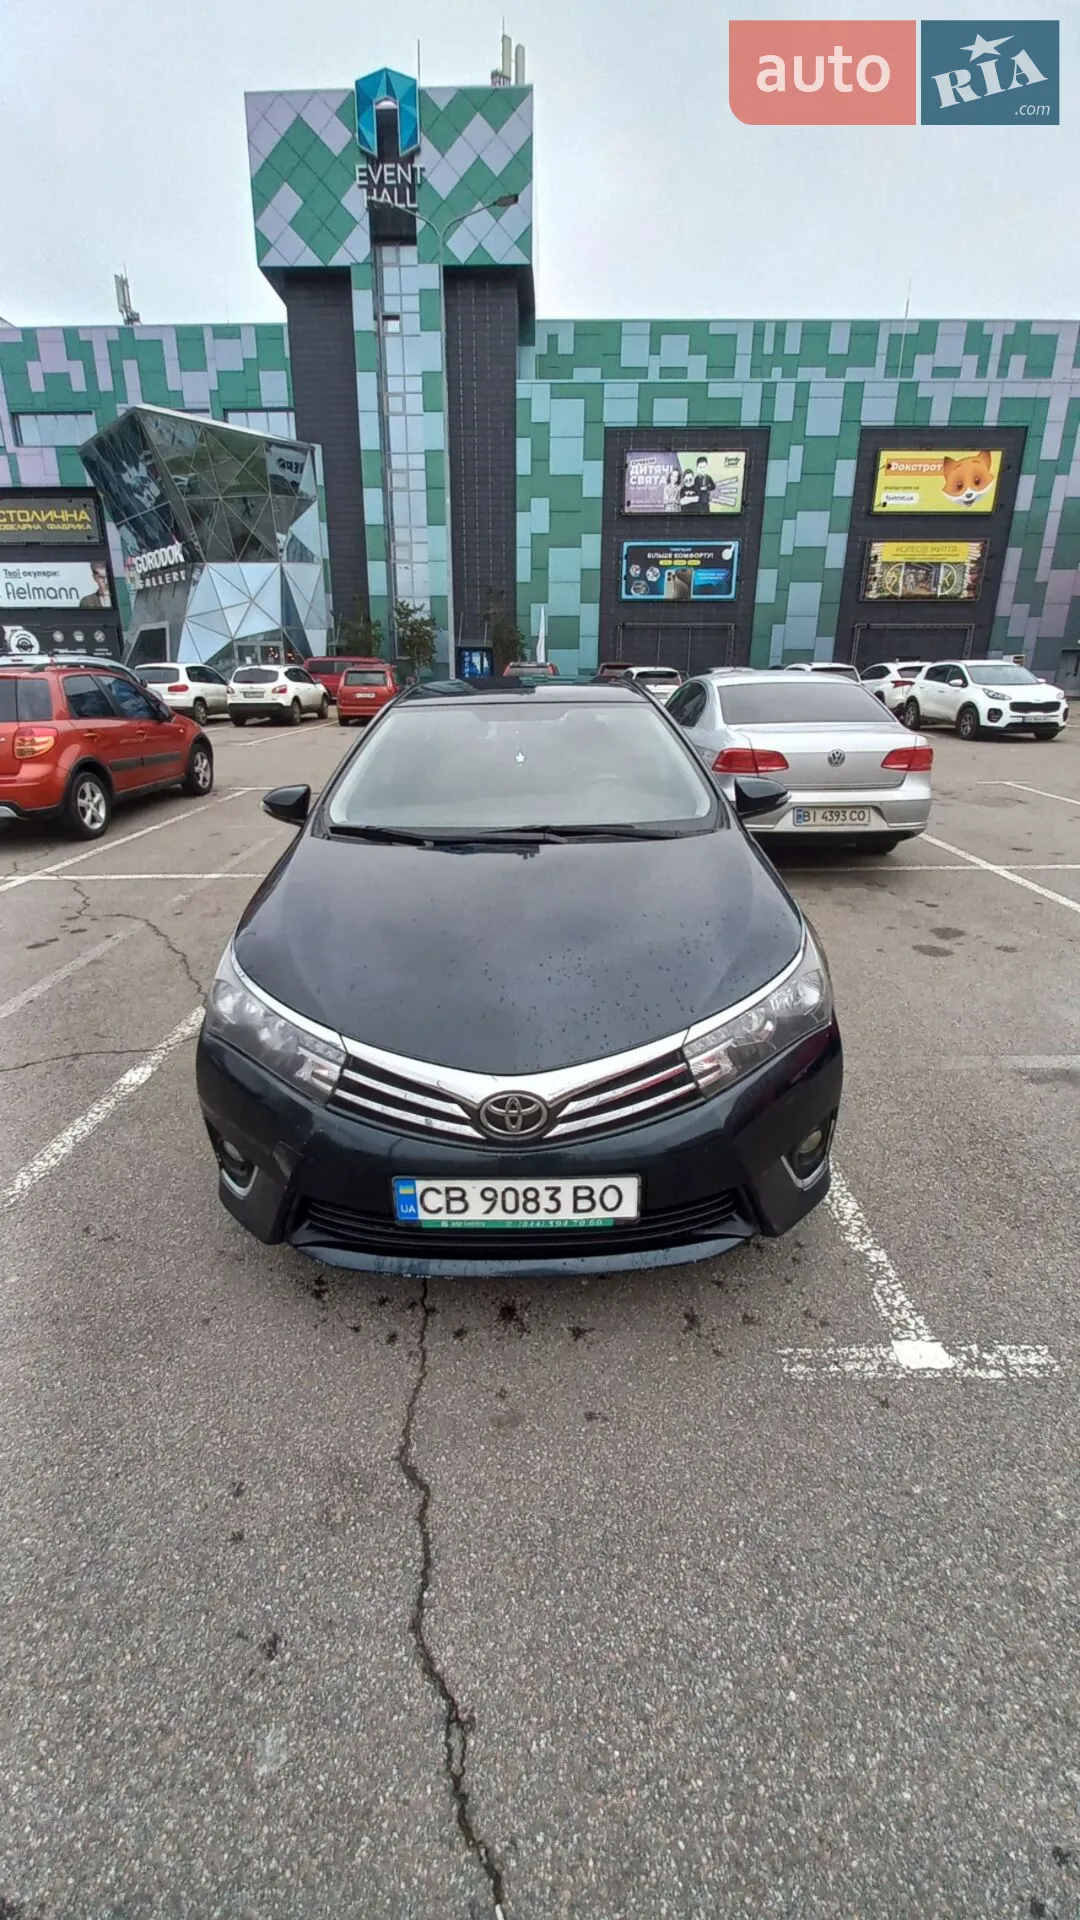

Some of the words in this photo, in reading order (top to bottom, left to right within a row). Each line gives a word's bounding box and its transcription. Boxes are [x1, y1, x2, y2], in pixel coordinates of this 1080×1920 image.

[355, 163, 425, 185] EVENT
[363, 186, 419, 209] HALL
[629, 463, 674, 476] ДИТЯЧІ
[629, 475, 668, 486] СВЯТА
[821, 810, 847, 822] 4393
[849, 810, 866, 822] CO
[419, 1186, 470, 1215] CB
[480, 1185, 562, 1215] 9083
[572, 1184, 623, 1214] BO
[400, 1204, 416, 1214] UA
